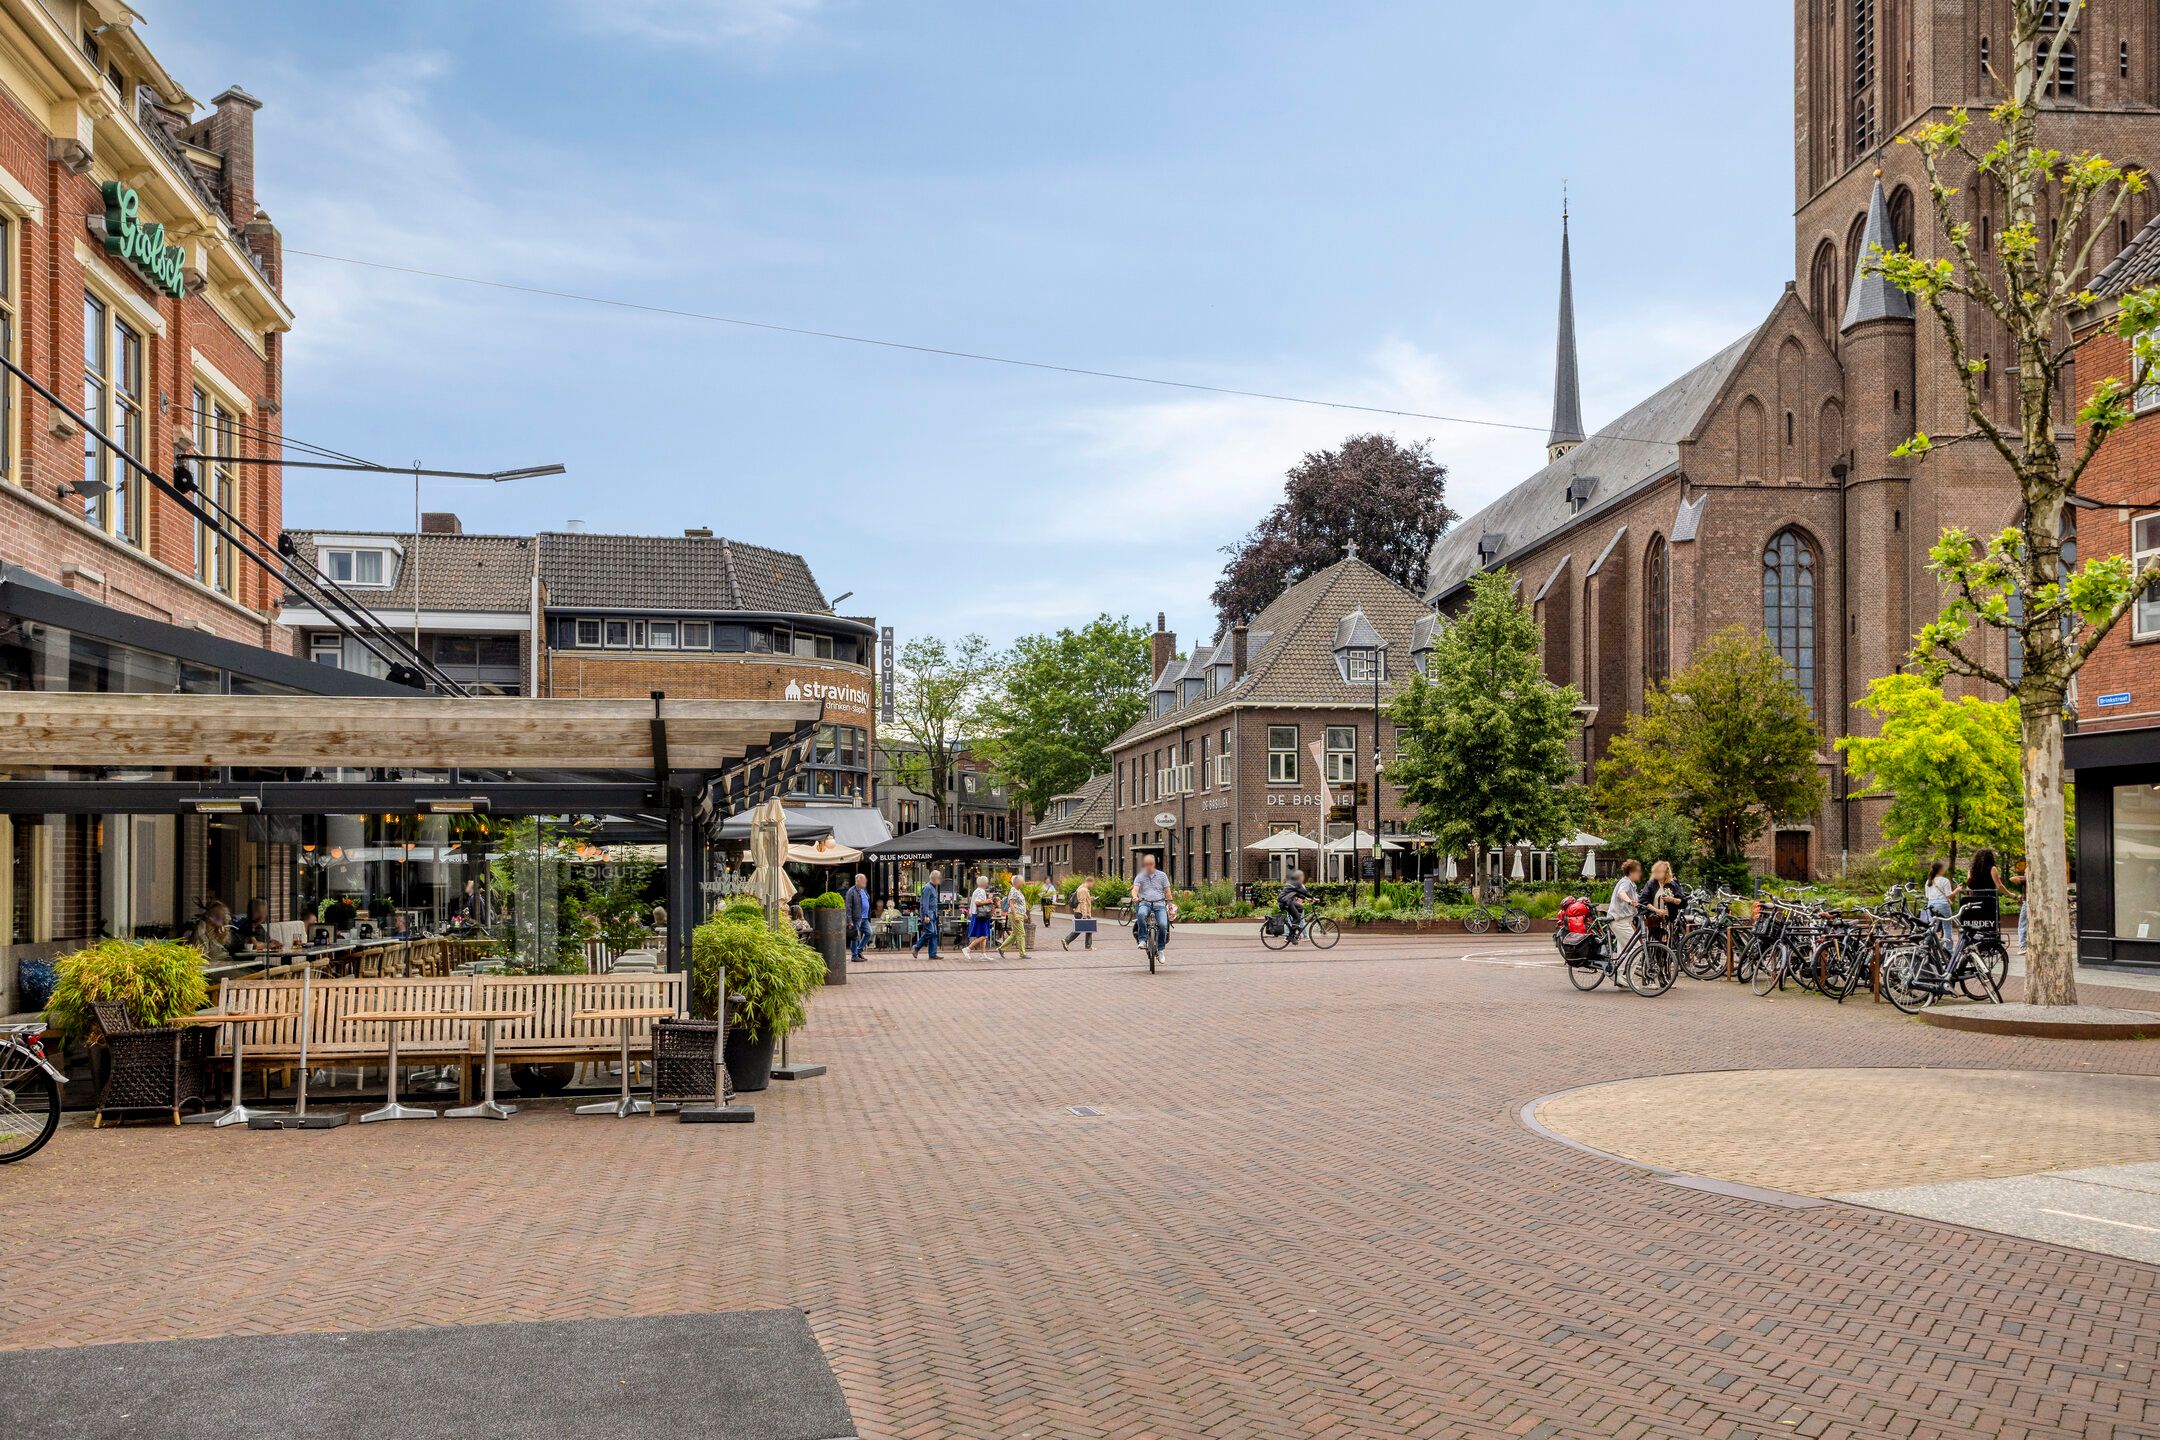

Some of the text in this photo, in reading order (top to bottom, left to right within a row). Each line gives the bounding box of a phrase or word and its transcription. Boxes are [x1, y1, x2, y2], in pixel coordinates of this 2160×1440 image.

[117, 181, 185, 299] Grolsch
[803, 681, 870, 708] stravinsky
[883, 645, 893, 706] HOTEL
[1267, 795, 1286, 806] DE
[1293, 794, 1356, 806] BASIE
